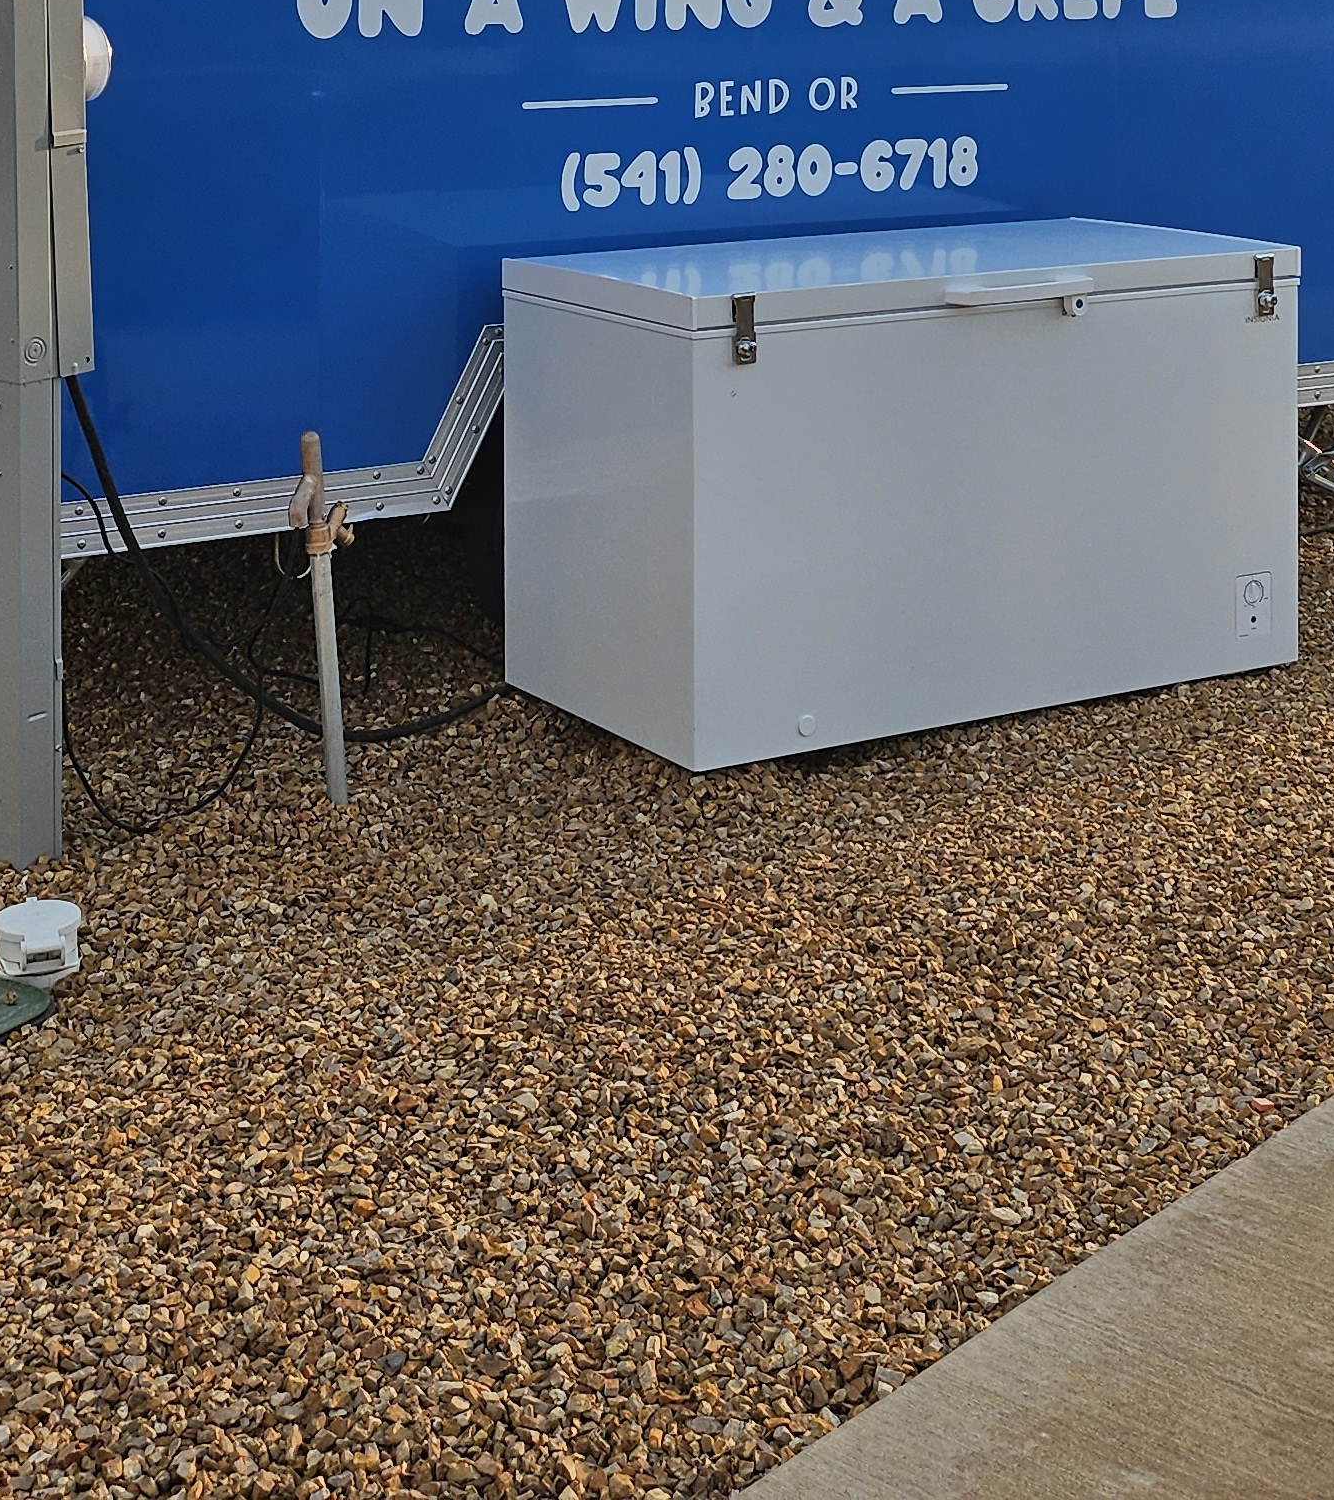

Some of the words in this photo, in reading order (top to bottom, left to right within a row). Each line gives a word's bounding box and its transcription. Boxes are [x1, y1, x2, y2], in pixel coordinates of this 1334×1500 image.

[694, 78, 790, 119] BEND
[808, 76, 859, 112] OR
[561, 146, 702, 212] (541)
[727, 135, 979, 201] 280-6718
